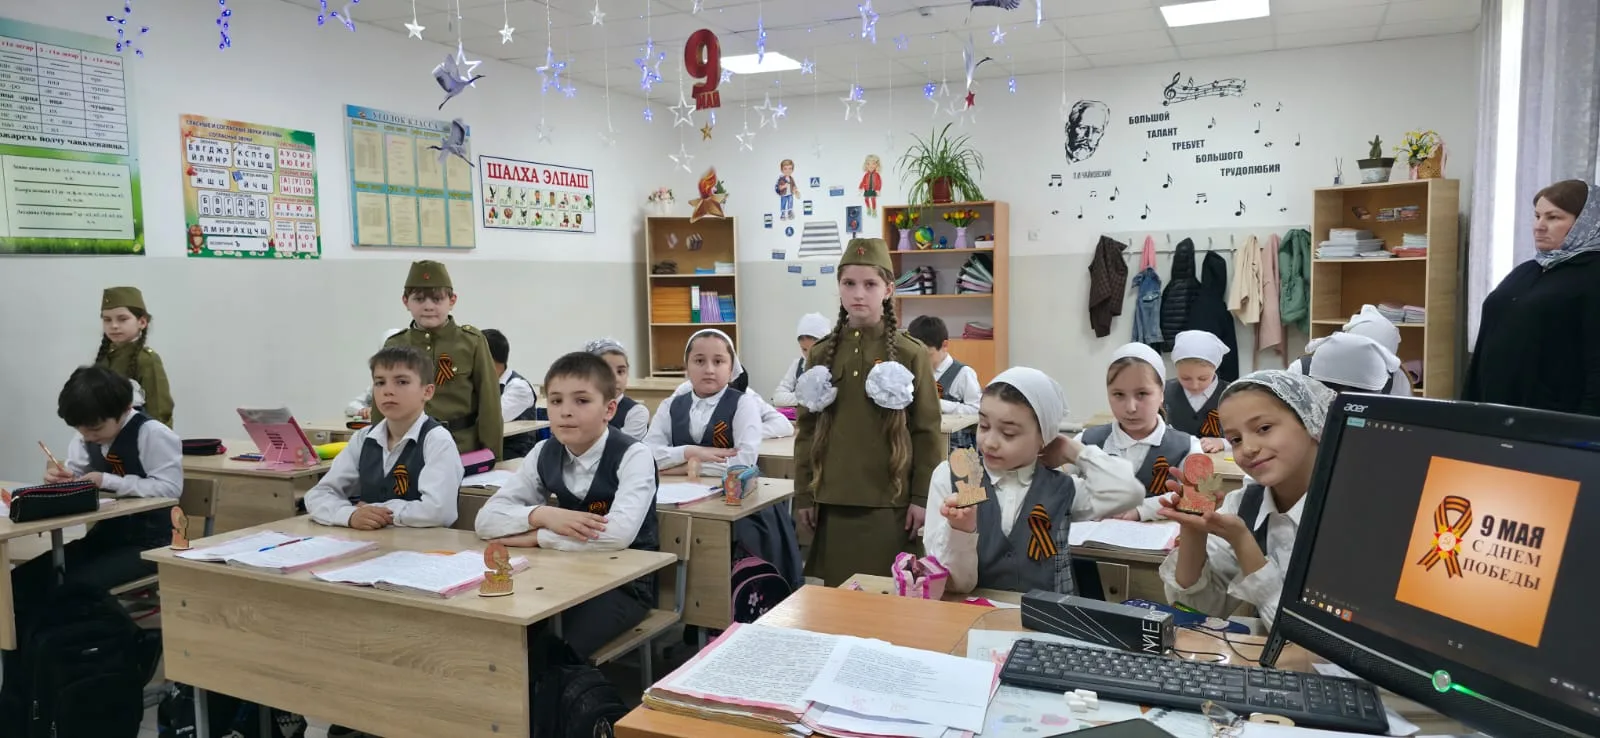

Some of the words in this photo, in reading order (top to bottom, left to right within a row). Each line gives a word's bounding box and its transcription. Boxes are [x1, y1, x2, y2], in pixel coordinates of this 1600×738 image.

[684, 28, 721, 98] 9
[1128, 111, 1170, 125] БОЛЬШОЙ
[1146, 127, 1178, 139] ТАЛАНТ
[1172, 139, 1205, 151] ТРЕБУЕТ
[1195, 151, 1243, 163] БОЛЬШОГО
[487, 163, 539, 184] ШАЛХА
[543, 170, 589, 189] ЭЛПАШ
[1220, 163, 1281, 177] ТРУДОЛЮБИЯ
[1344, 403, 1369, 413] acer
[1479, 514, 1495, 537] 9
[1499, 518, 1545, 550] МАЯ
[1472, 538, 1484, 553] С
[1488, 543, 1542, 568] ДНЕМ
[1463, 557, 1541, 592] ПОБЕДЫ
